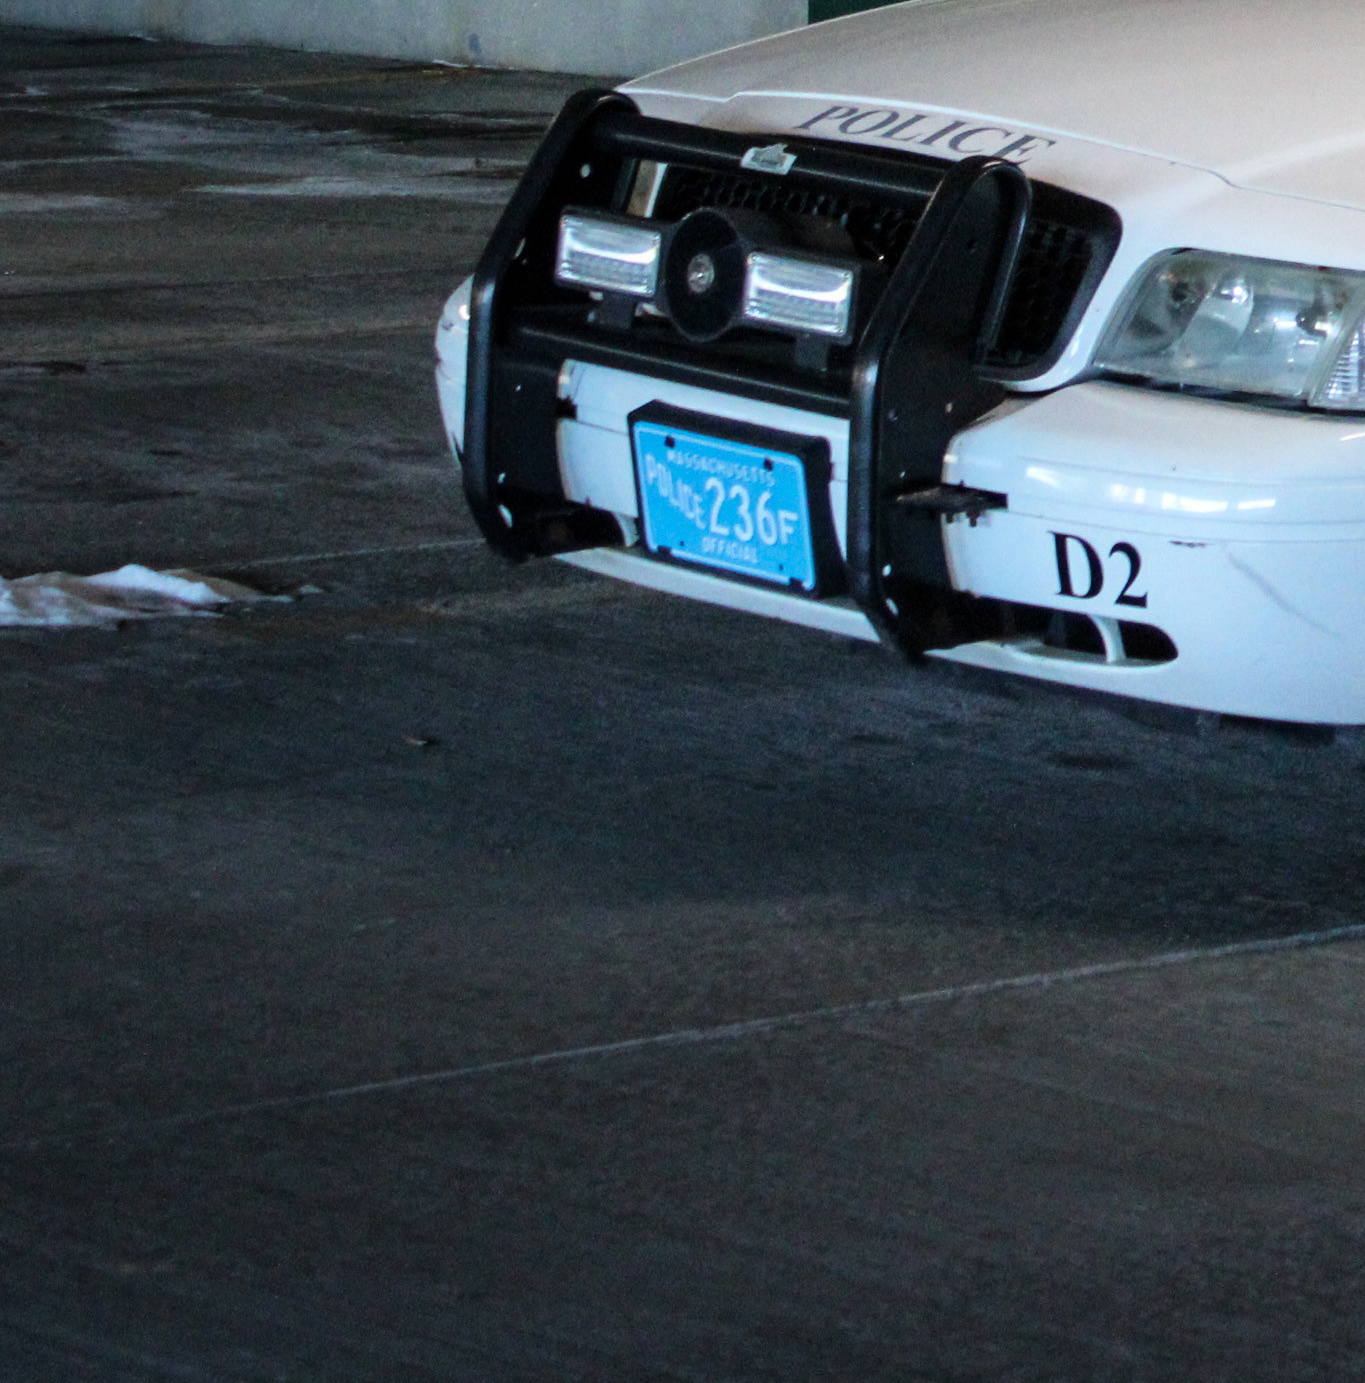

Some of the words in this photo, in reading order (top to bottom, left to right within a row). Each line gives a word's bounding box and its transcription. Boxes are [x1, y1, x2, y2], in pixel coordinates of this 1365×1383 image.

[795, 106, 1057, 165] POLICE
[645, 454, 705, 529] POLICE
[667, 449, 774, 487] MASSACHUSETTS
[706, 477, 798, 546] 236F
[702, 537, 757, 563] OFFICIAL
[1047, 530, 1147, 608] D2
